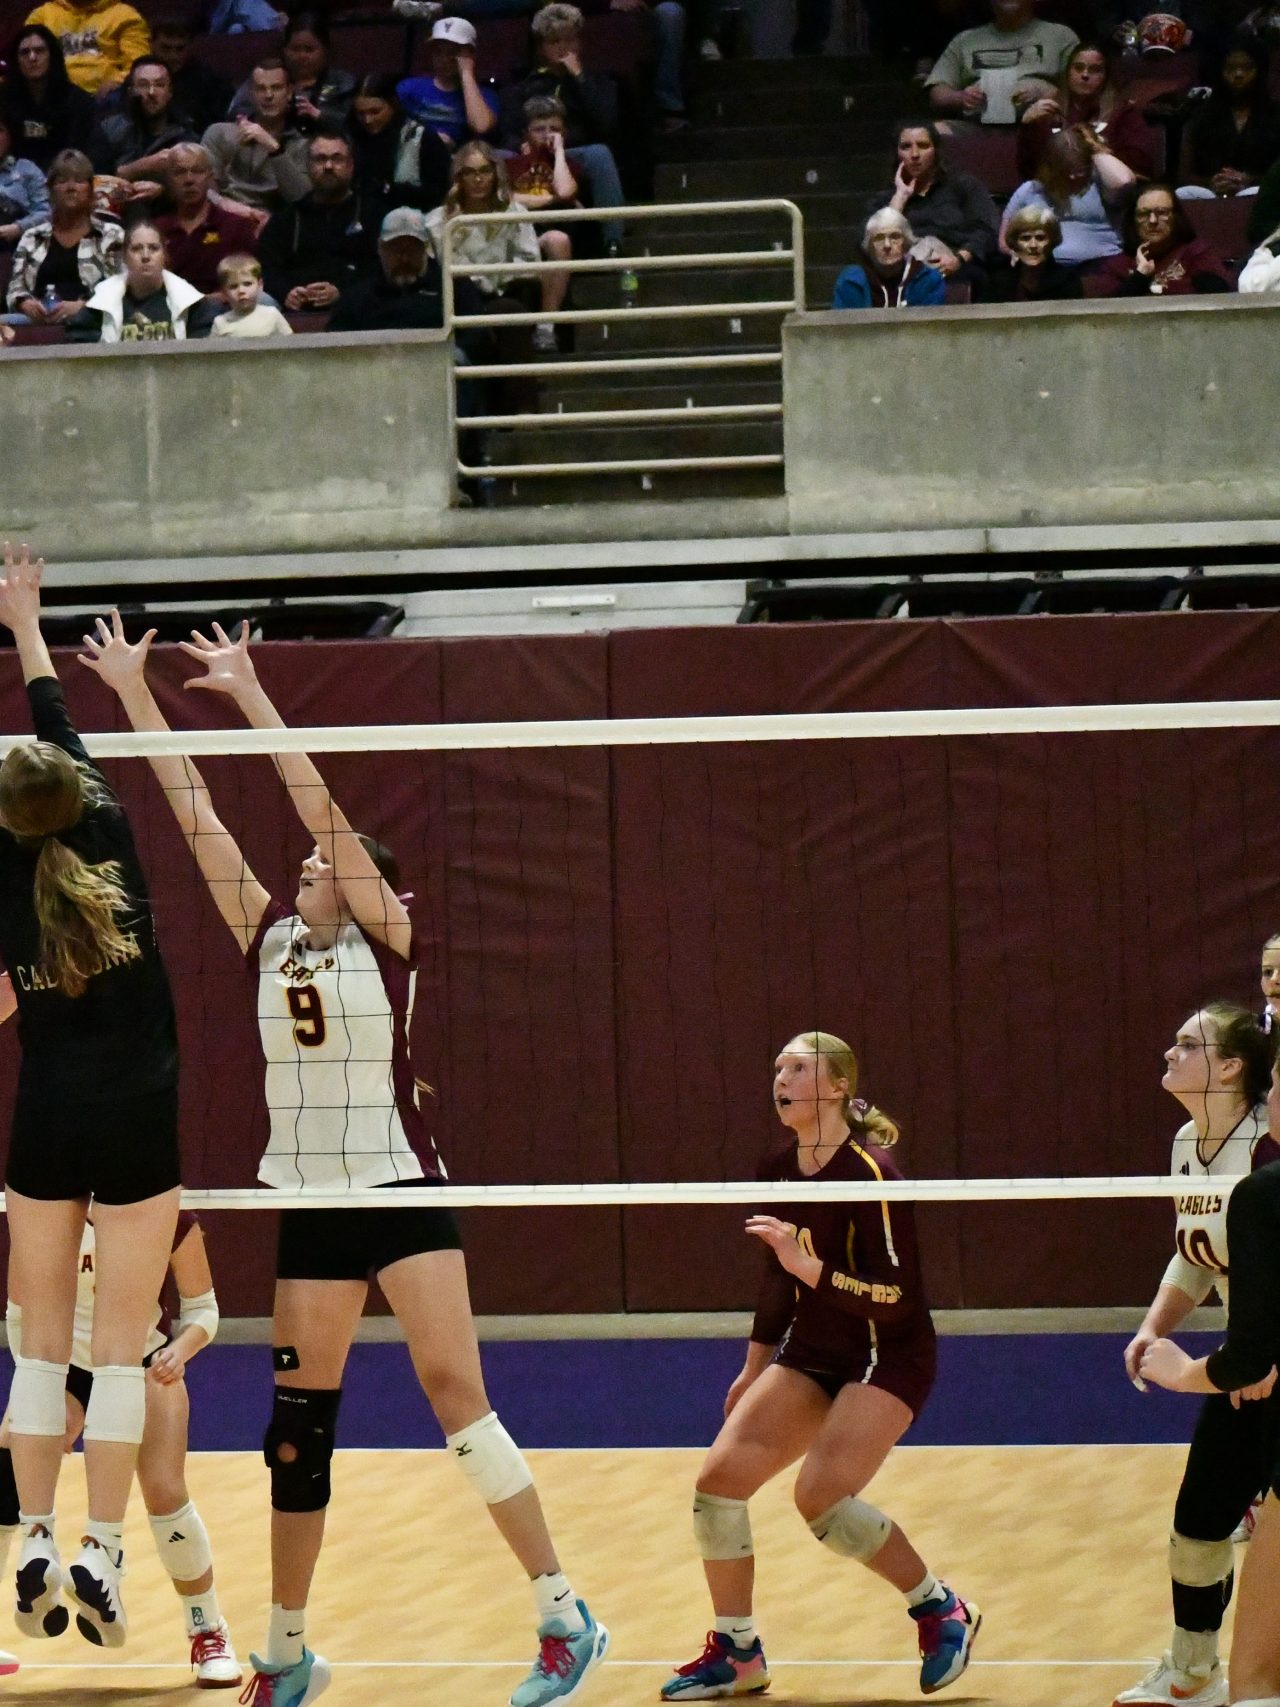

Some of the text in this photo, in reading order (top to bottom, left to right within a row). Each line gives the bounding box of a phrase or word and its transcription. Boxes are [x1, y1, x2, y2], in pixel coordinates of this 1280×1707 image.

[286, 984, 327, 1048] 9
[1179, 1194, 1223, 1216] EAGLES
[1176, 1228, 1229, 1276] 10
